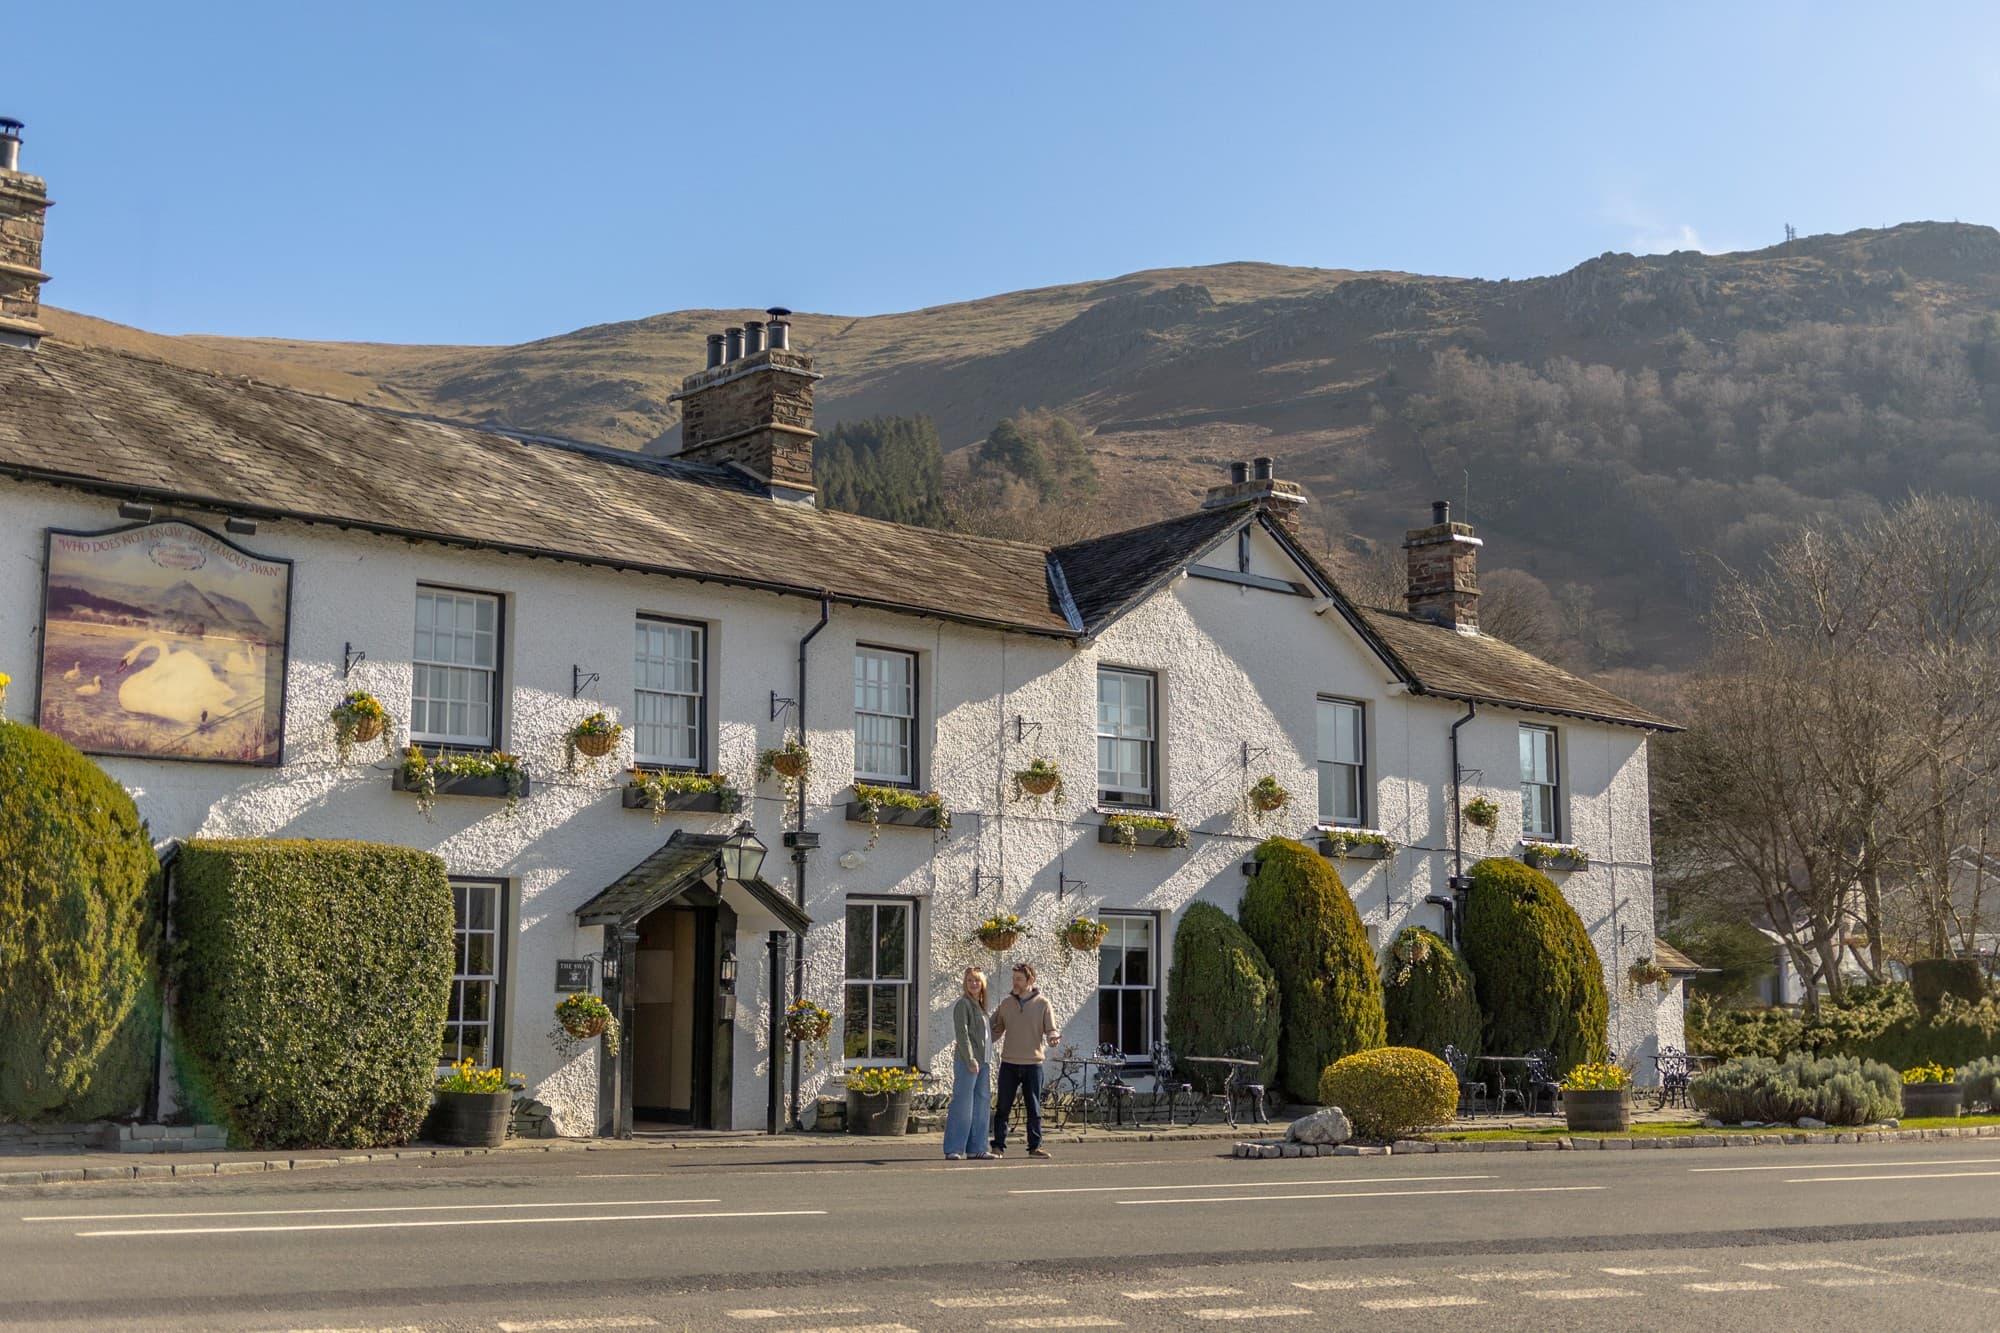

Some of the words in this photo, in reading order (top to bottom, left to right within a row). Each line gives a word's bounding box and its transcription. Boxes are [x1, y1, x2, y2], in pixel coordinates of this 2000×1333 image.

[92, 537, 120, 553] DOES
[122, 531, 145, 545] NOT
[148, 526, 184, 540] KNOW
[186, 530, 210, 546] THE
[209, 542, 248, 569] FAMOUS
